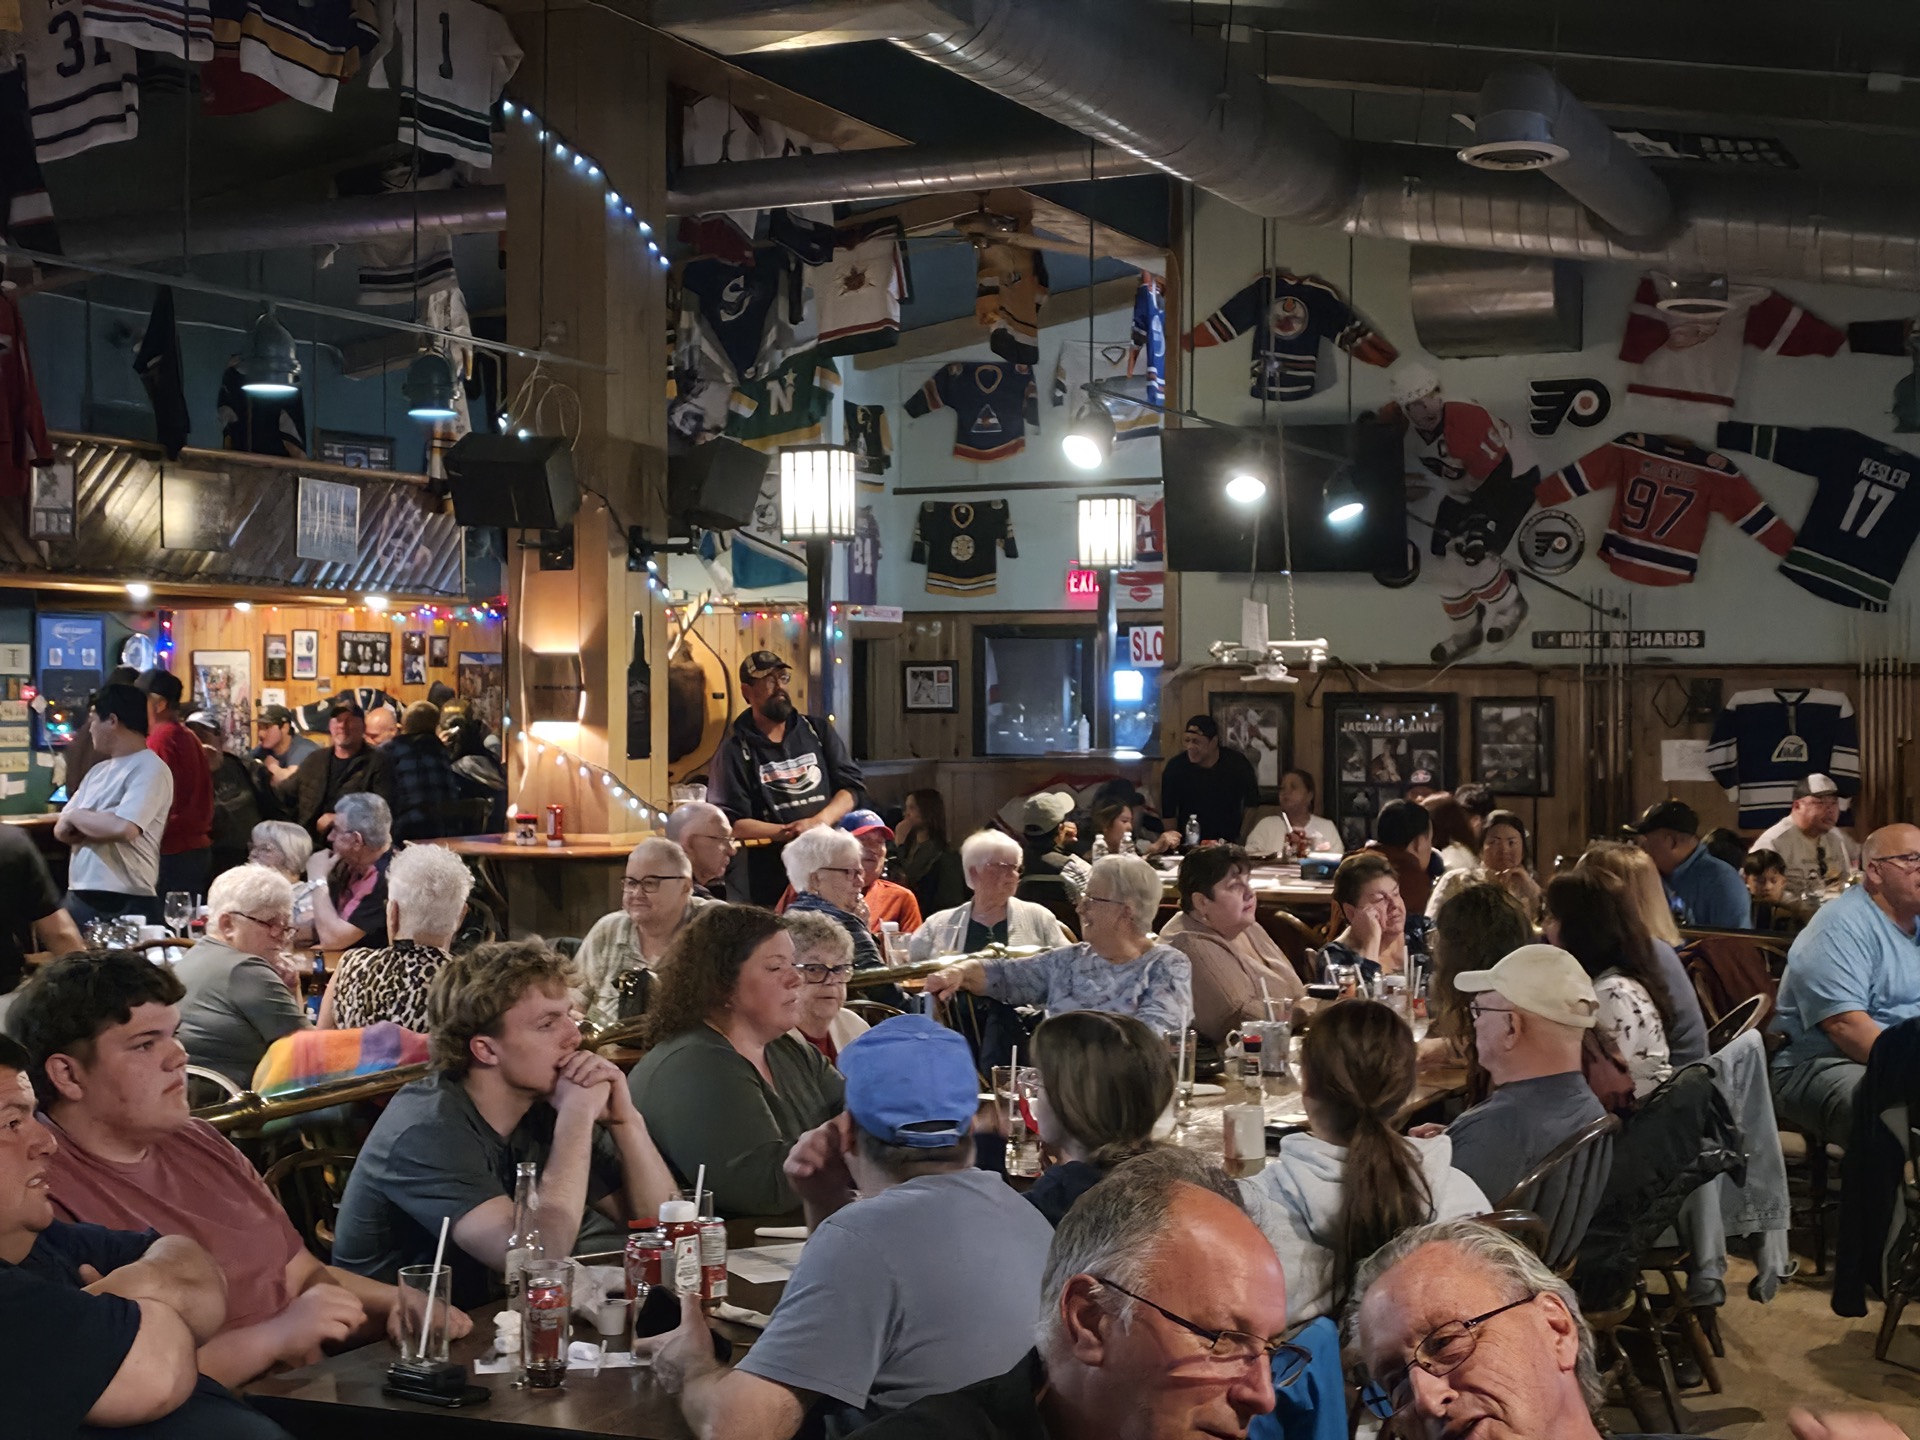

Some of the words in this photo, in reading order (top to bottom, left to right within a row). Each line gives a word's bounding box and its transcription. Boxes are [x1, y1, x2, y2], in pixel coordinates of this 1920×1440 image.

[48, 10, 111, 78] 31
[438, 11, 454, 81] 1
[765, 379, 795, 416] N
[1858, 457, 1911, 490] KESLER
[1619, 476, 1698, 539] 97
[1839, 478, 1897, 540] 17
[1069, 567, 1100, 593] EXI
[1560, 631, 1605, 647] MIKE
[1609, 631, 1700, 648] RICHARDS
[1341, 722, 1393, 734] JACQUES
